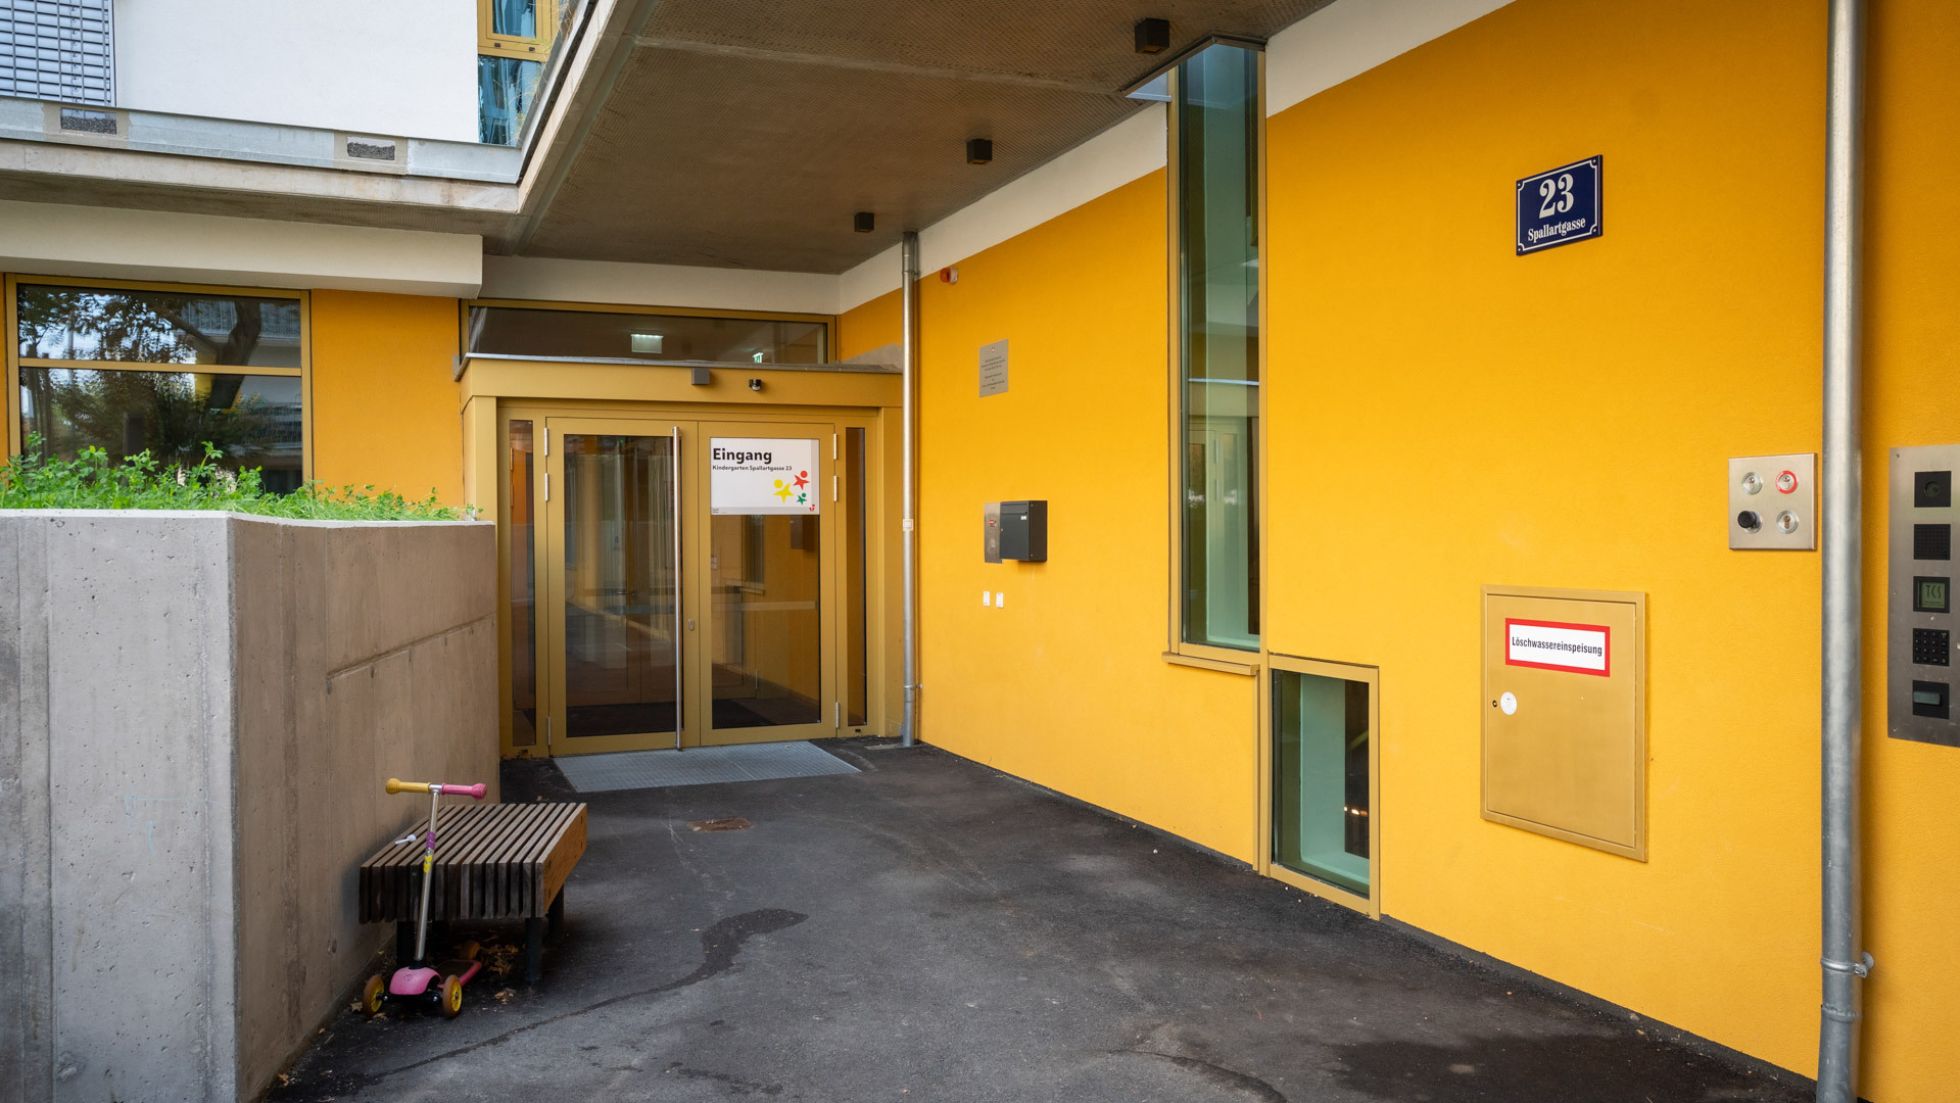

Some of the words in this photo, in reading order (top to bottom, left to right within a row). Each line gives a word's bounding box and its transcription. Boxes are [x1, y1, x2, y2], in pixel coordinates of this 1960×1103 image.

[1539, 173, 1574, 219] 23
[1527, 217, 1586, 243] Spallartgasse
[713, 448, 772, 464] Eingang
[1511, 636, 1603, 657] Löschwassereinspeisung
